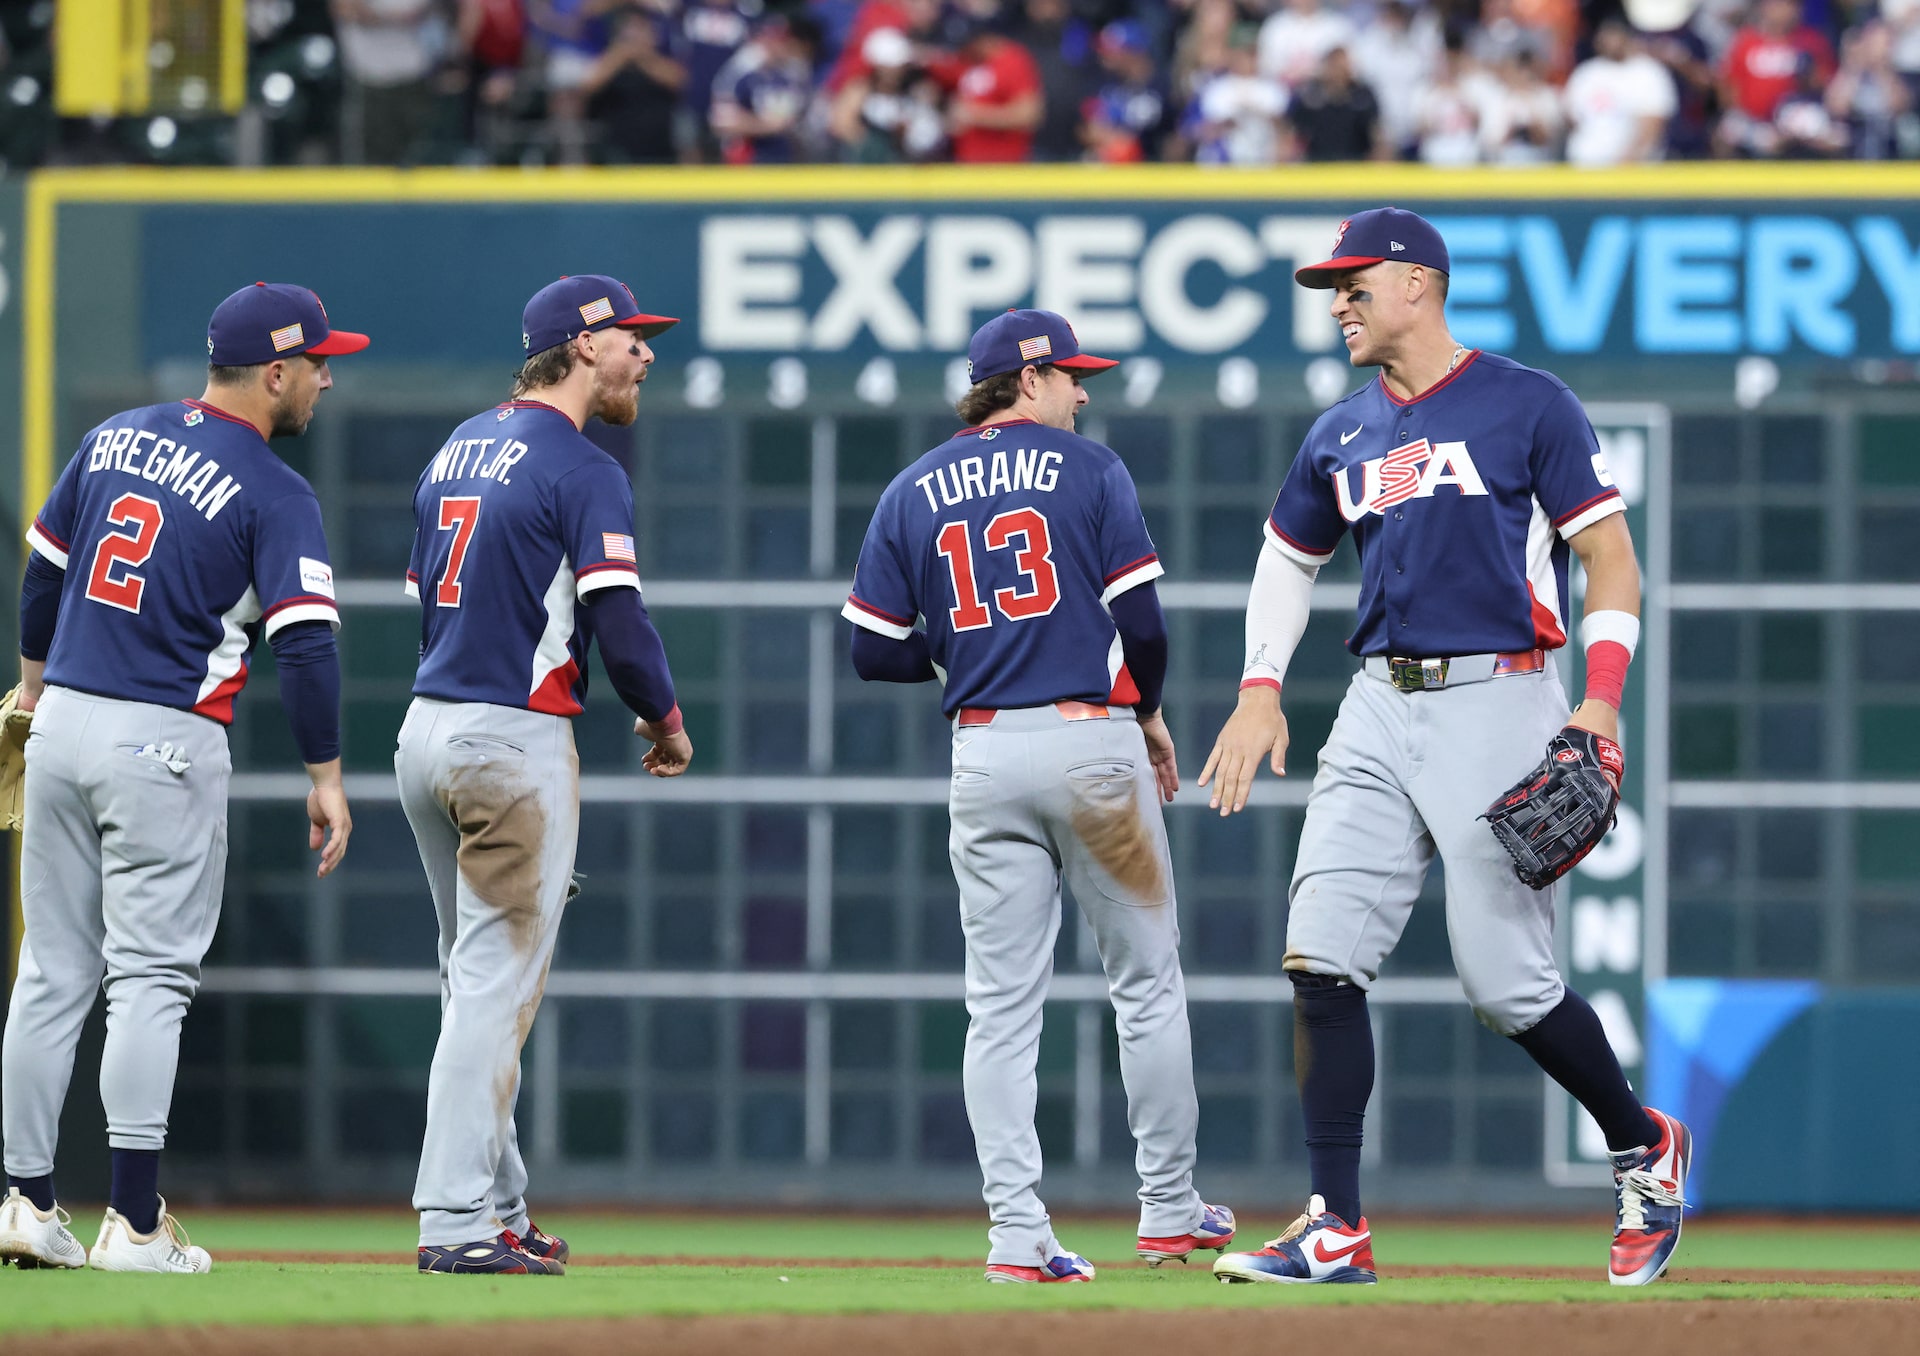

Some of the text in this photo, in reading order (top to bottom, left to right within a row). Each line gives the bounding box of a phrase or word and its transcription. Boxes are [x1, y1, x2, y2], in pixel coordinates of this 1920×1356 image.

[703, 214, 1354, 353] EXPECT
[88, 427, 242, 522] BREGMAN
[431, 438, 528, 485] WITT JR.
[915, 448, 1064, 513] TURANG
[1331, 437, 1489, 522] USA
[85, 491, 164, 615] 2
[436, 495, 481, 608] 7
[935, 506, 1061, 633] 13
